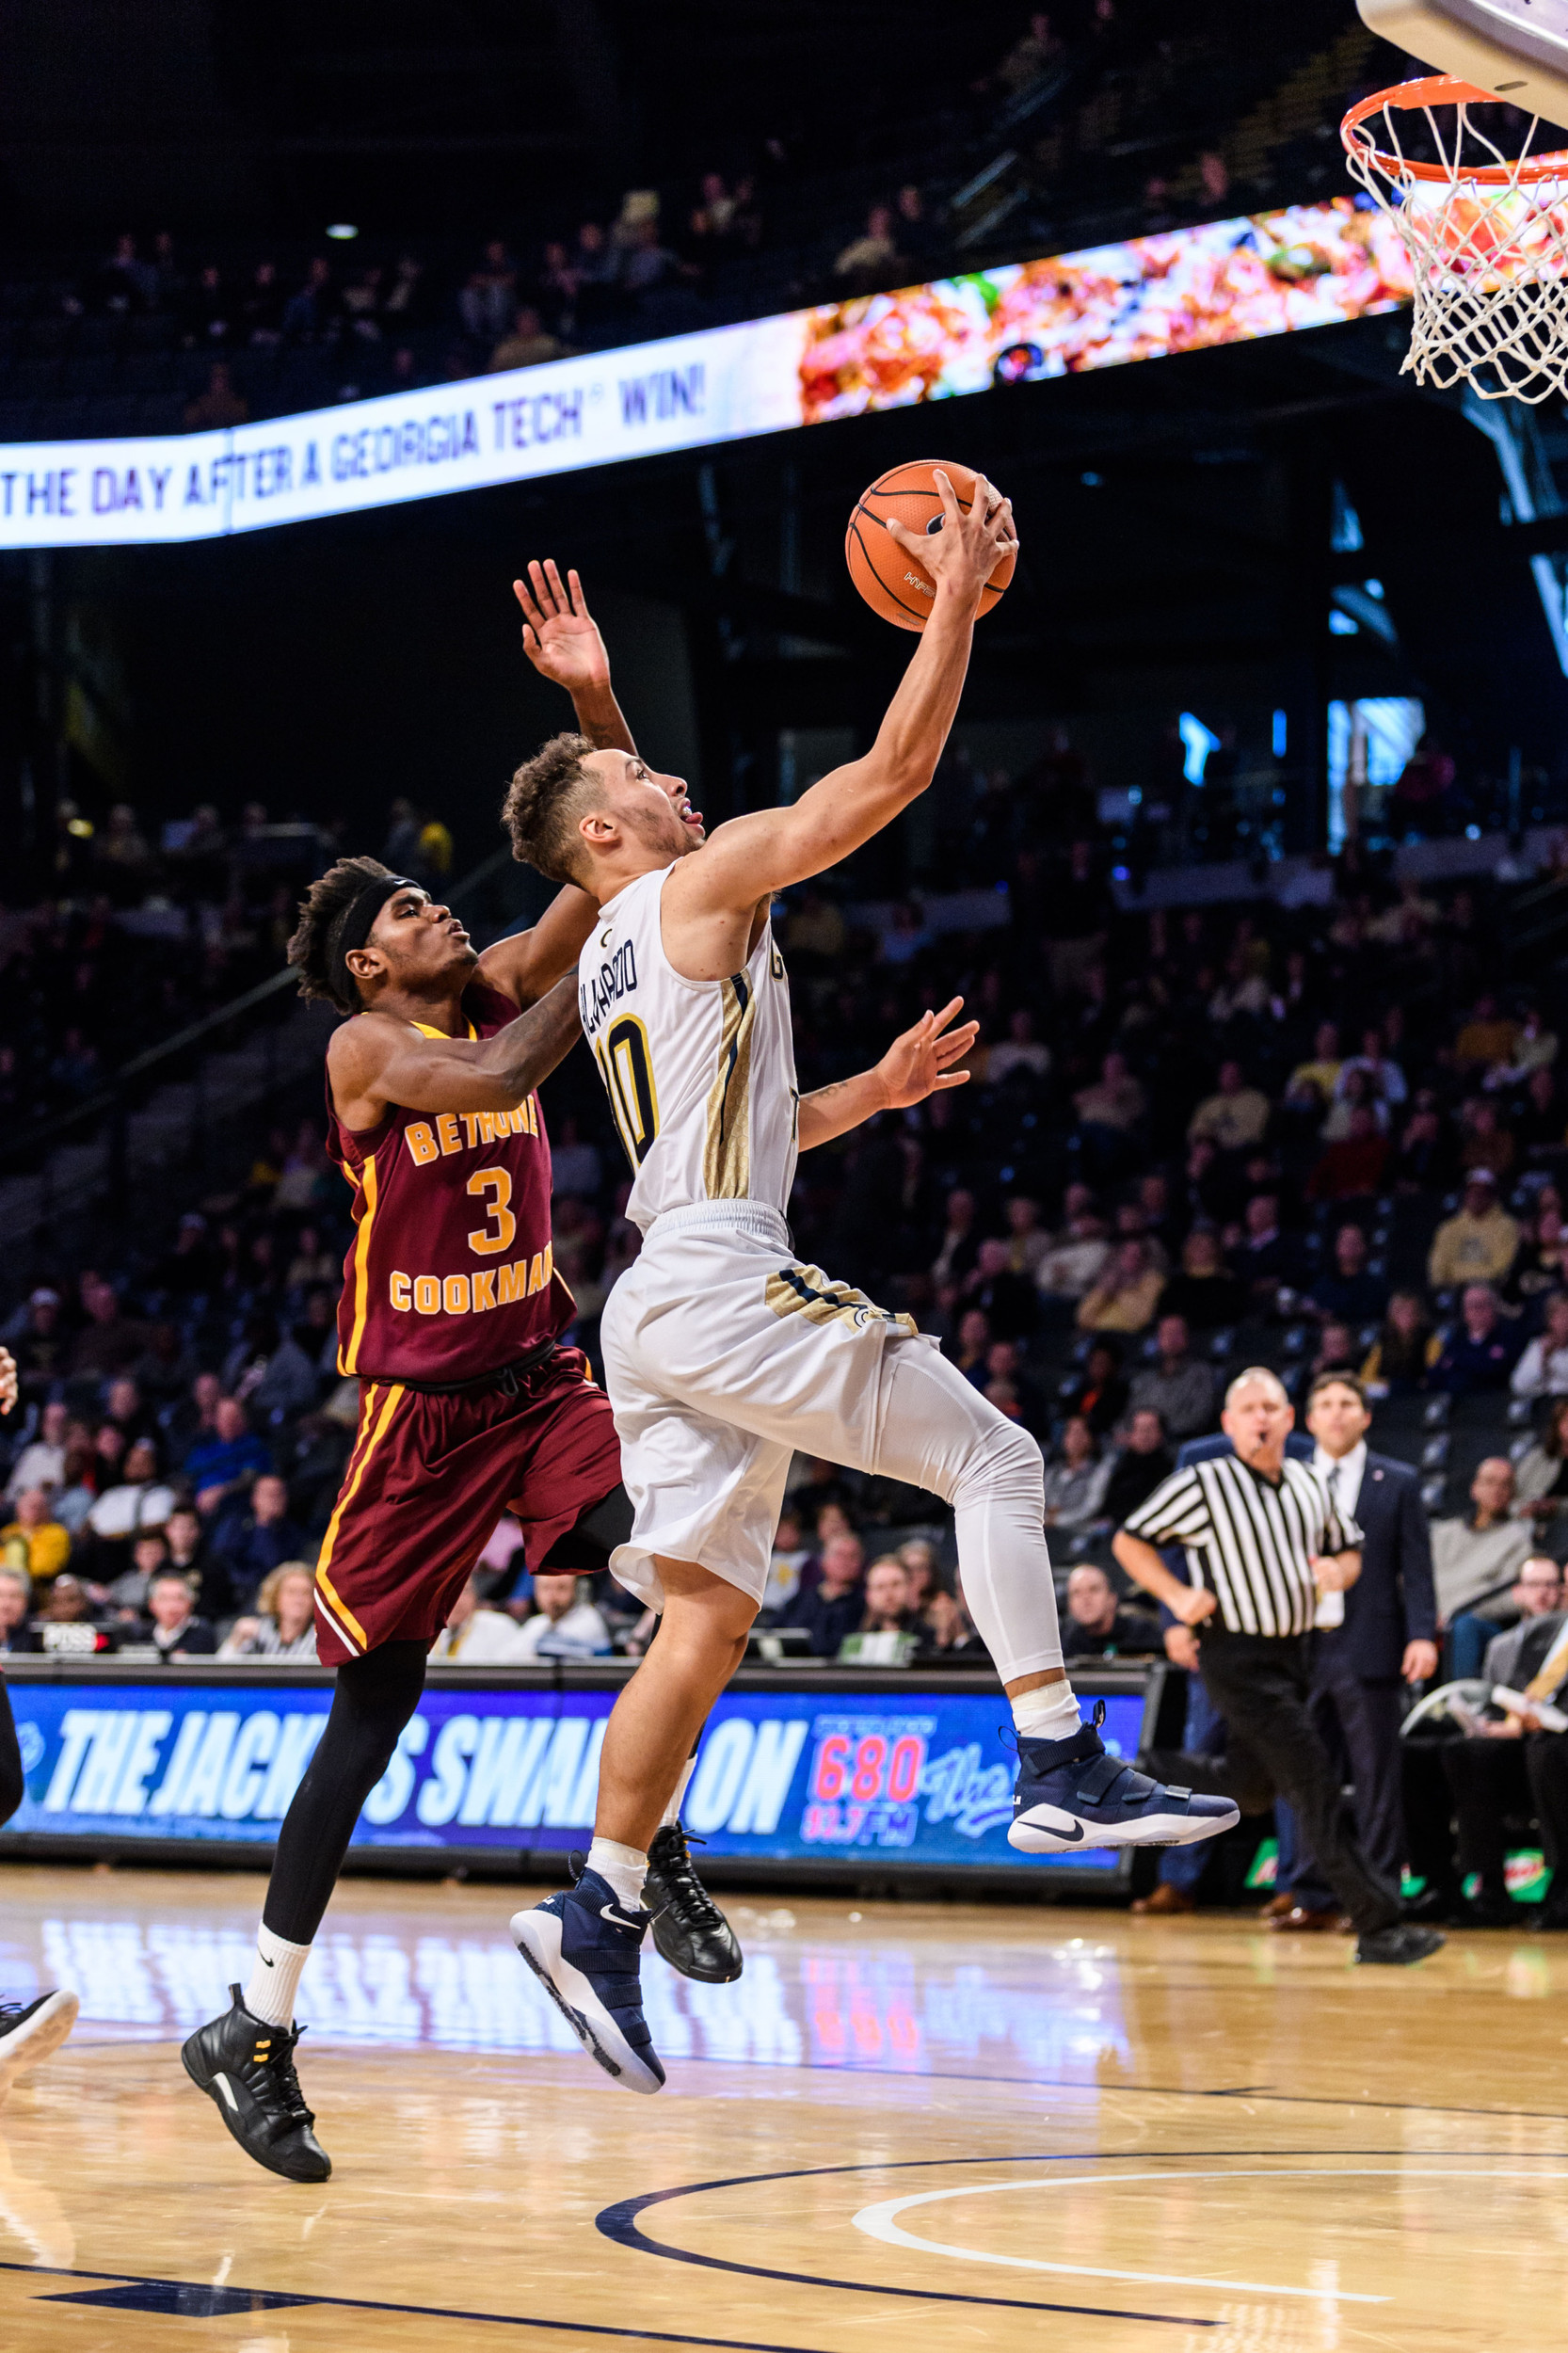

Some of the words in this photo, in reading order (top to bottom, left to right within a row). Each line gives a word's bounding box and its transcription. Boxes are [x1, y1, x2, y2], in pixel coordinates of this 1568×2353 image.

[1, 471, 77, 517] THE
[92, 467, 173, 516] DAY
[184, 446, 294, 506] AFTER
[300, 438, 322, 491] A
[330, 408, 480, 484] GEORGIA
[617, 361, 706, 428] WIN!
[466, 1165, 517, 1256] 3
[43, 1709, 172, 1815] THE
[684, 1718, 809, 1834] ON
[815, 1736, 921, 1804] 680
